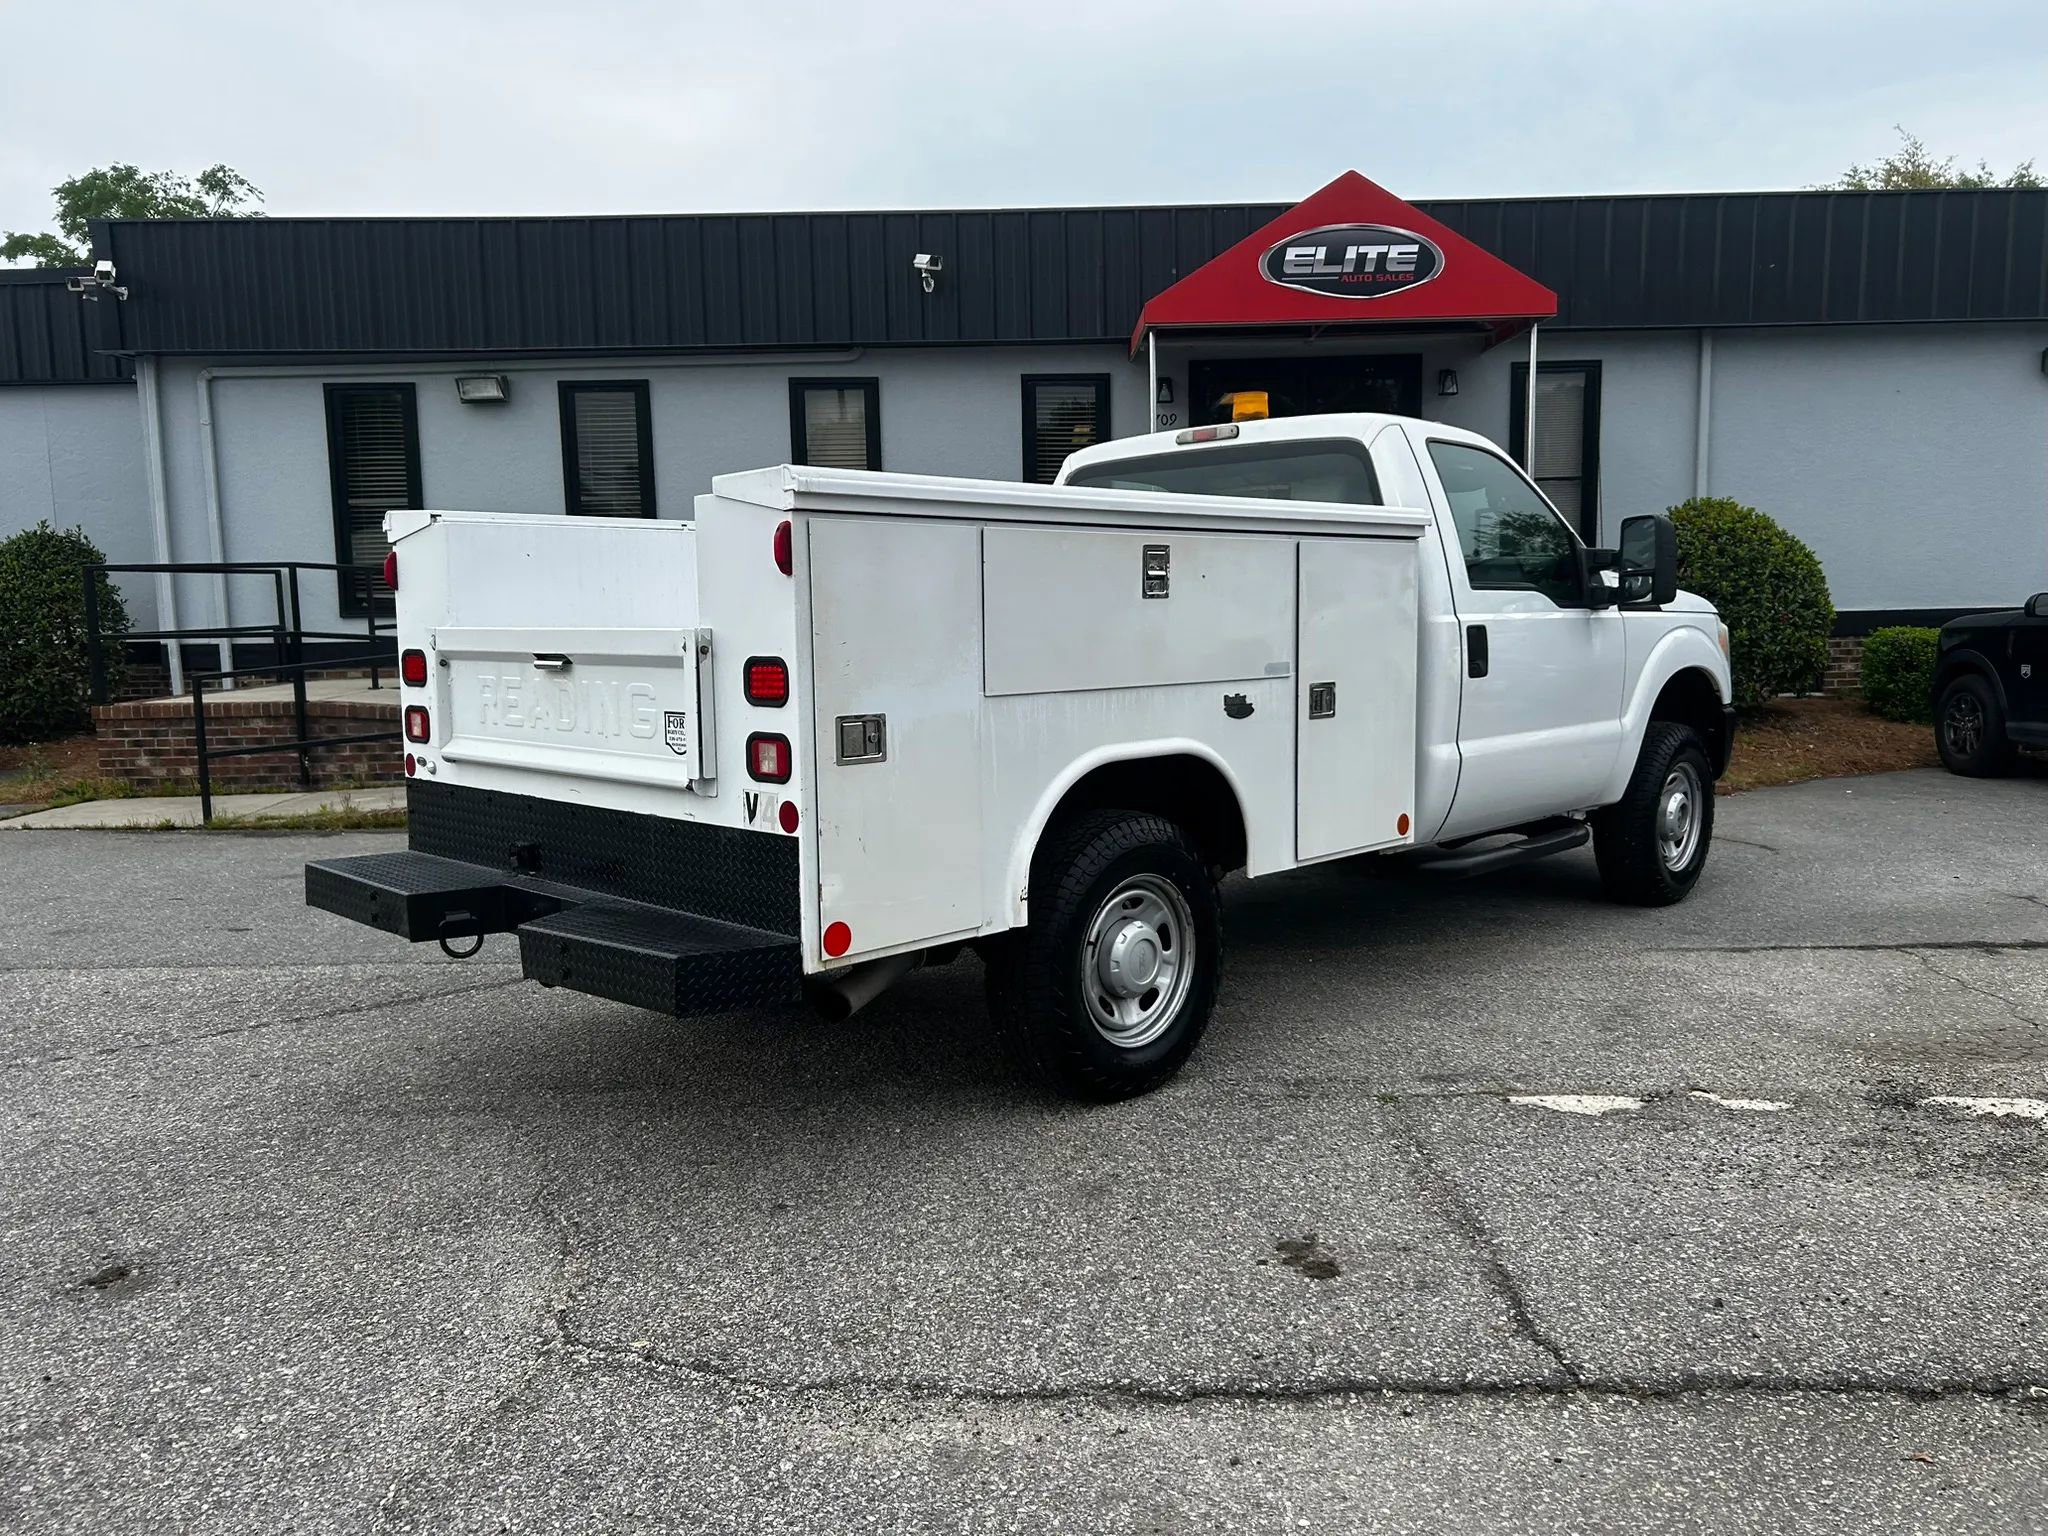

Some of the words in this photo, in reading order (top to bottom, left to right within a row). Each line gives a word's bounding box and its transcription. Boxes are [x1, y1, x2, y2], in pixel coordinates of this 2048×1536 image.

[1283, 244, 1420, 274] ELITE
[1341, 274, 1373, 283] AUTO
[1376, 273, 1415, 282] SALES
[477, 675, 658, 740] READING
